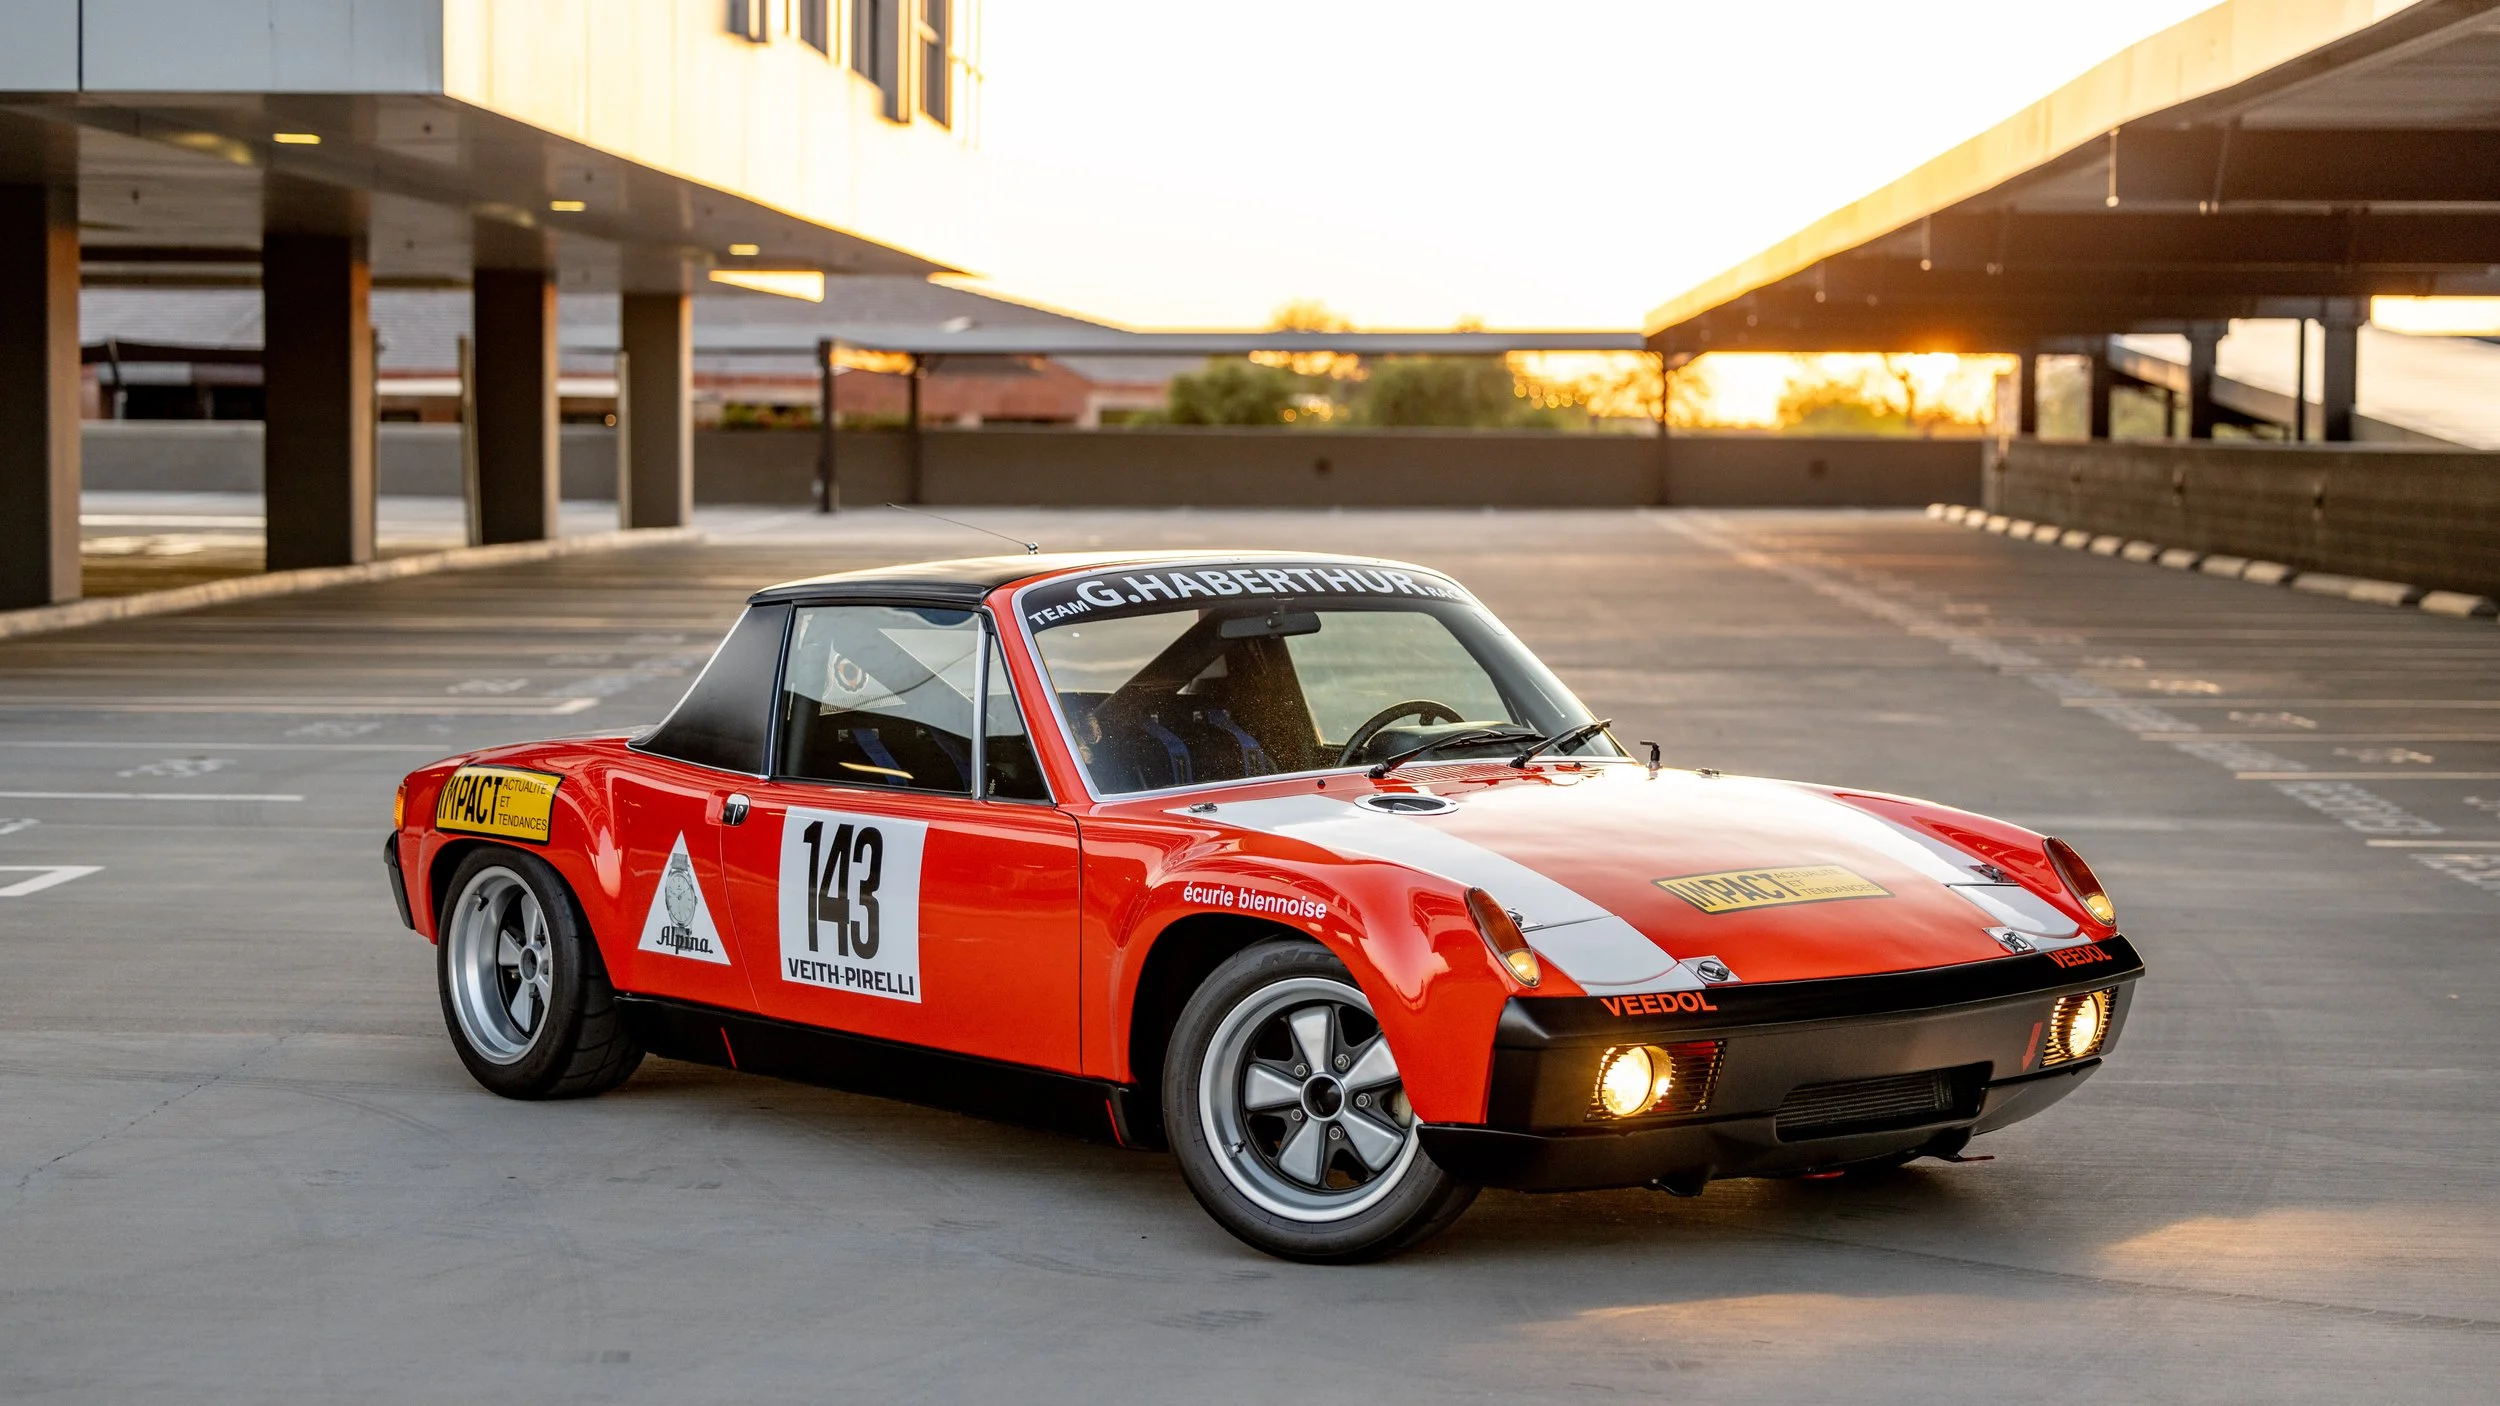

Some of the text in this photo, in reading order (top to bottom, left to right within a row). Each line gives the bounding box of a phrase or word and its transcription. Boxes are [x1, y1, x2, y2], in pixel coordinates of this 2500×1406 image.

[1028, 600, 1092, 626] TEAM
[1076, 568, 1429, 607] G.HABERTHUR
[438, 774, 504, 825] IMPACT
[500, 795, 511, 808] ET
[498, 813, 547, 831] TENDANCES
[803, 820, 884, 960] 143
[1183, 881, 1328, 919] écurie biennoise
[1666, 873, 1801, 908] IMPACT
[1786, 880, 1805, 888] ET
[2044, 944, 2112, 969] VEEDOL
[788, 957, 915, 996] VEITH-PIRELLI
[1600, 991, 1718, 1017] VEEDOL
